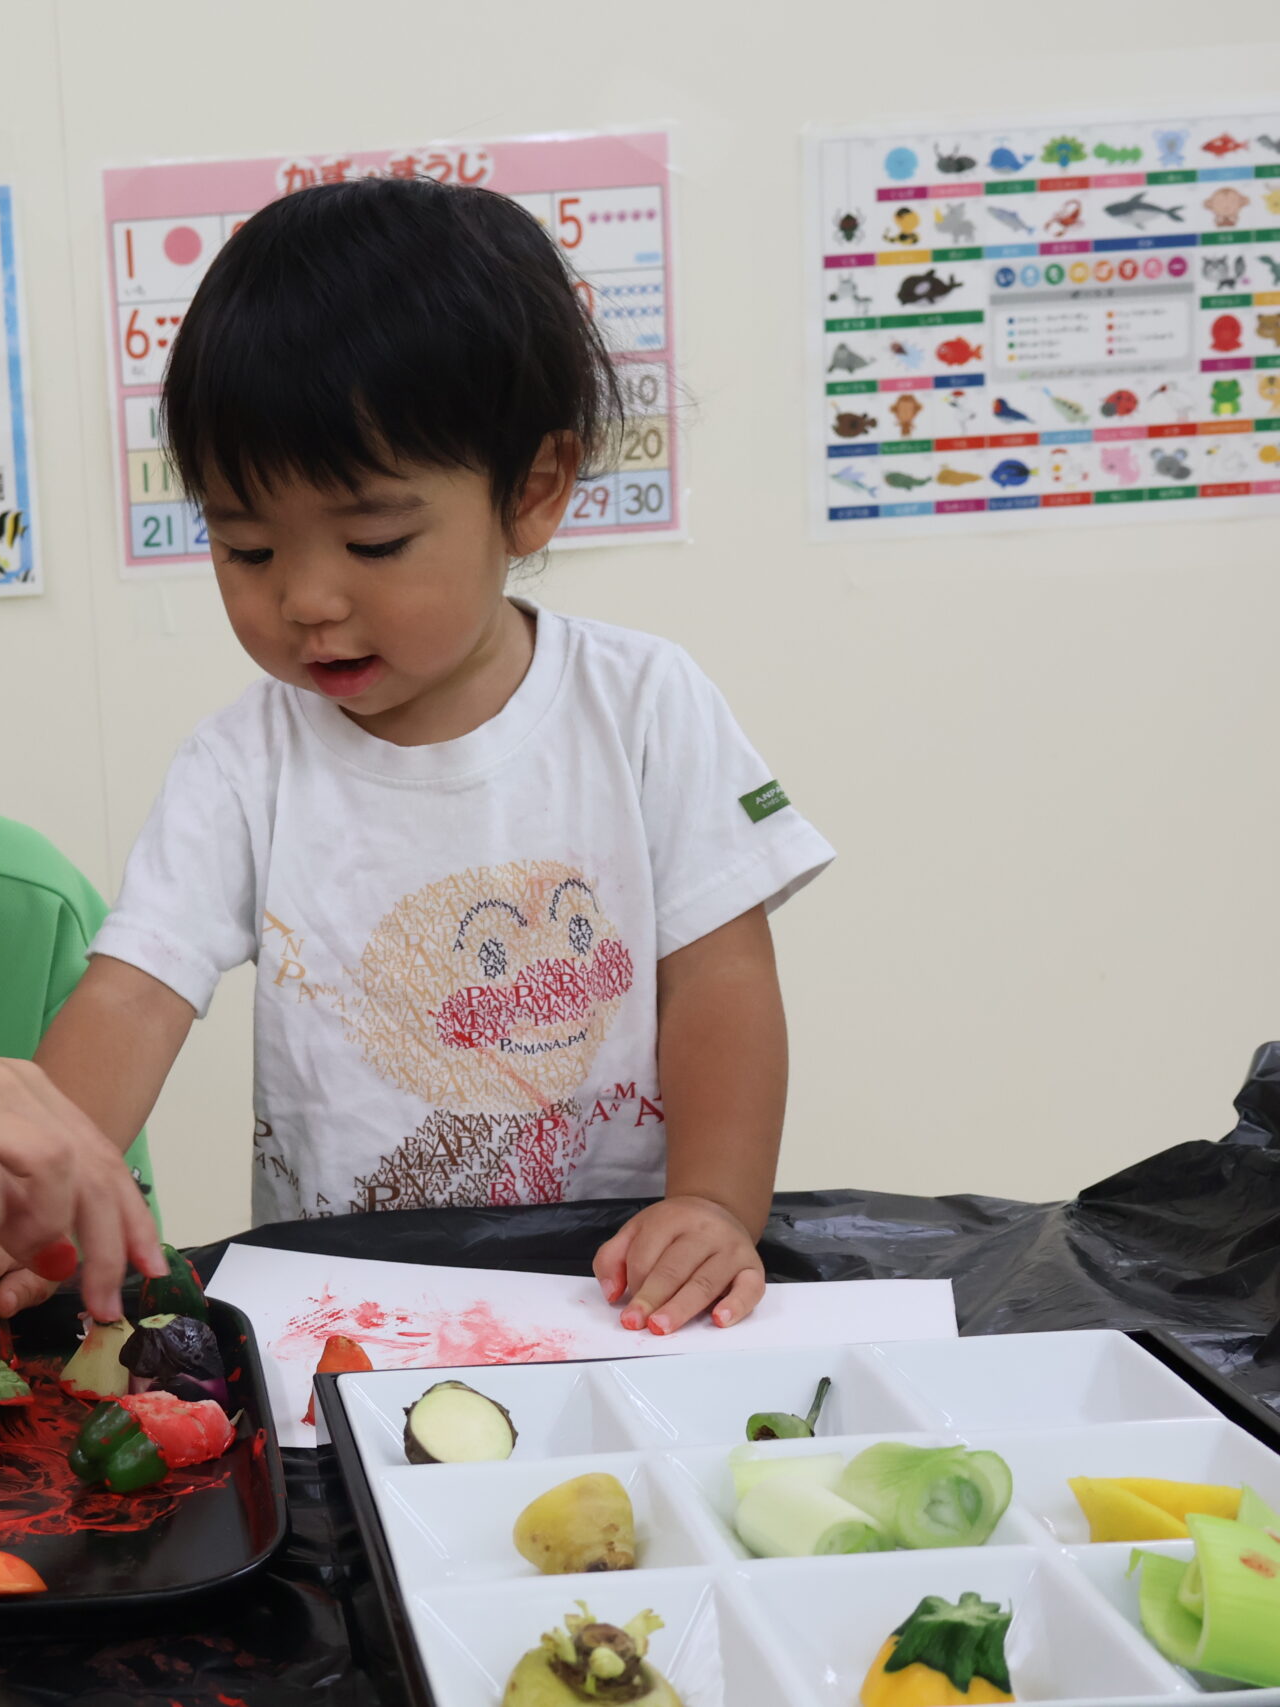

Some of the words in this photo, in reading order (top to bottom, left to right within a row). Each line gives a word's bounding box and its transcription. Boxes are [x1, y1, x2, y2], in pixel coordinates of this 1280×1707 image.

[559, 198, 583, 248] 5
[125, 229, 134, 279] 1
[125, 309, 150, 360] 6
[623, 428, 663, 461] 20
[572, 485, 610, 519] 29
[624, 483, 664, 516] 30
[143, 515, 173, 548] 21
